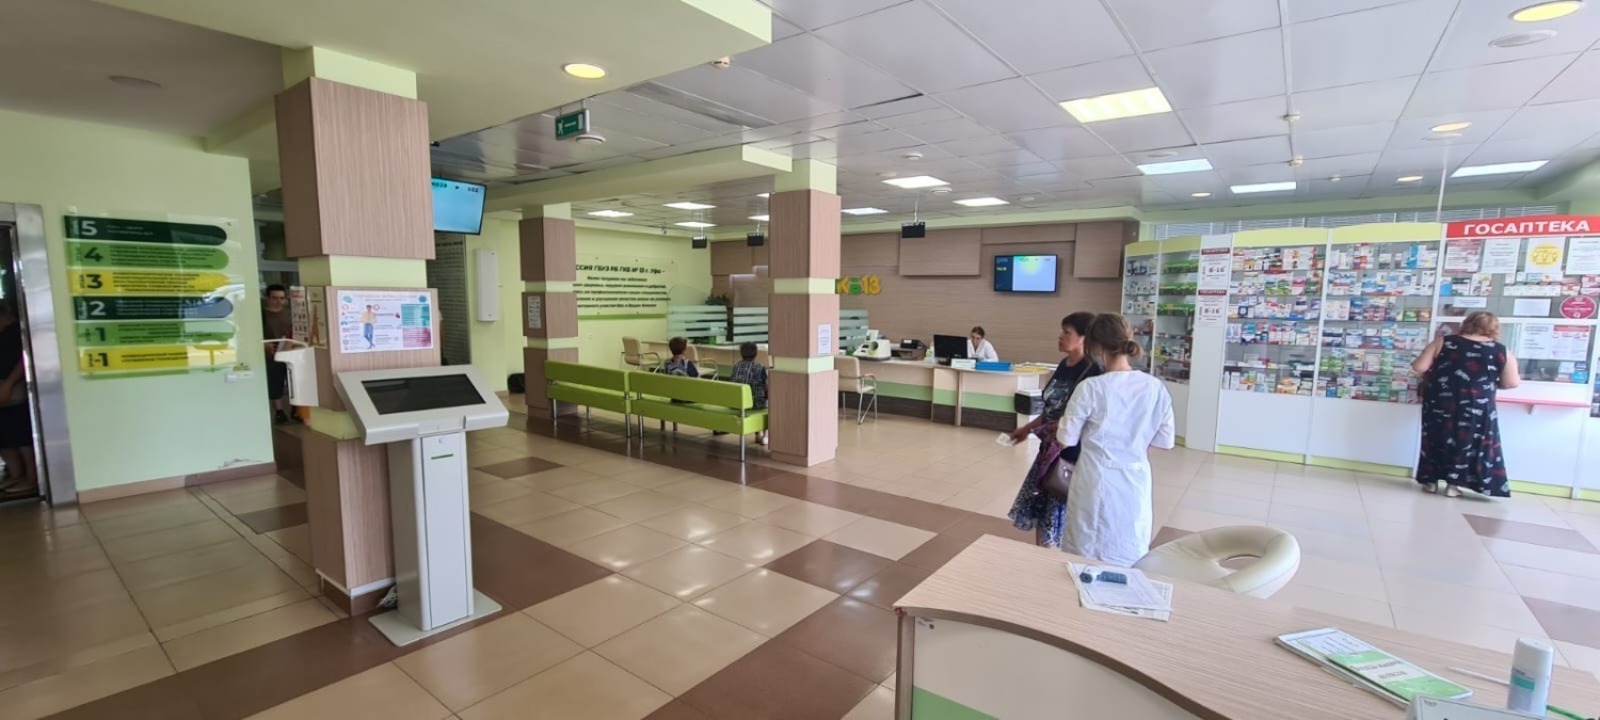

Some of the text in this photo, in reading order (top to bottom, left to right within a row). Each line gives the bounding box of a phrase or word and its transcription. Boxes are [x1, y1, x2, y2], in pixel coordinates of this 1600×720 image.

[81, 220, 98, 236] 5
[1463, 220, 1590, 235] ГОСАПТЕКА
[84, 246, 103, 262] 4
[85, 273, 103, 289] 3
[89, 300, 106, 316] 2
